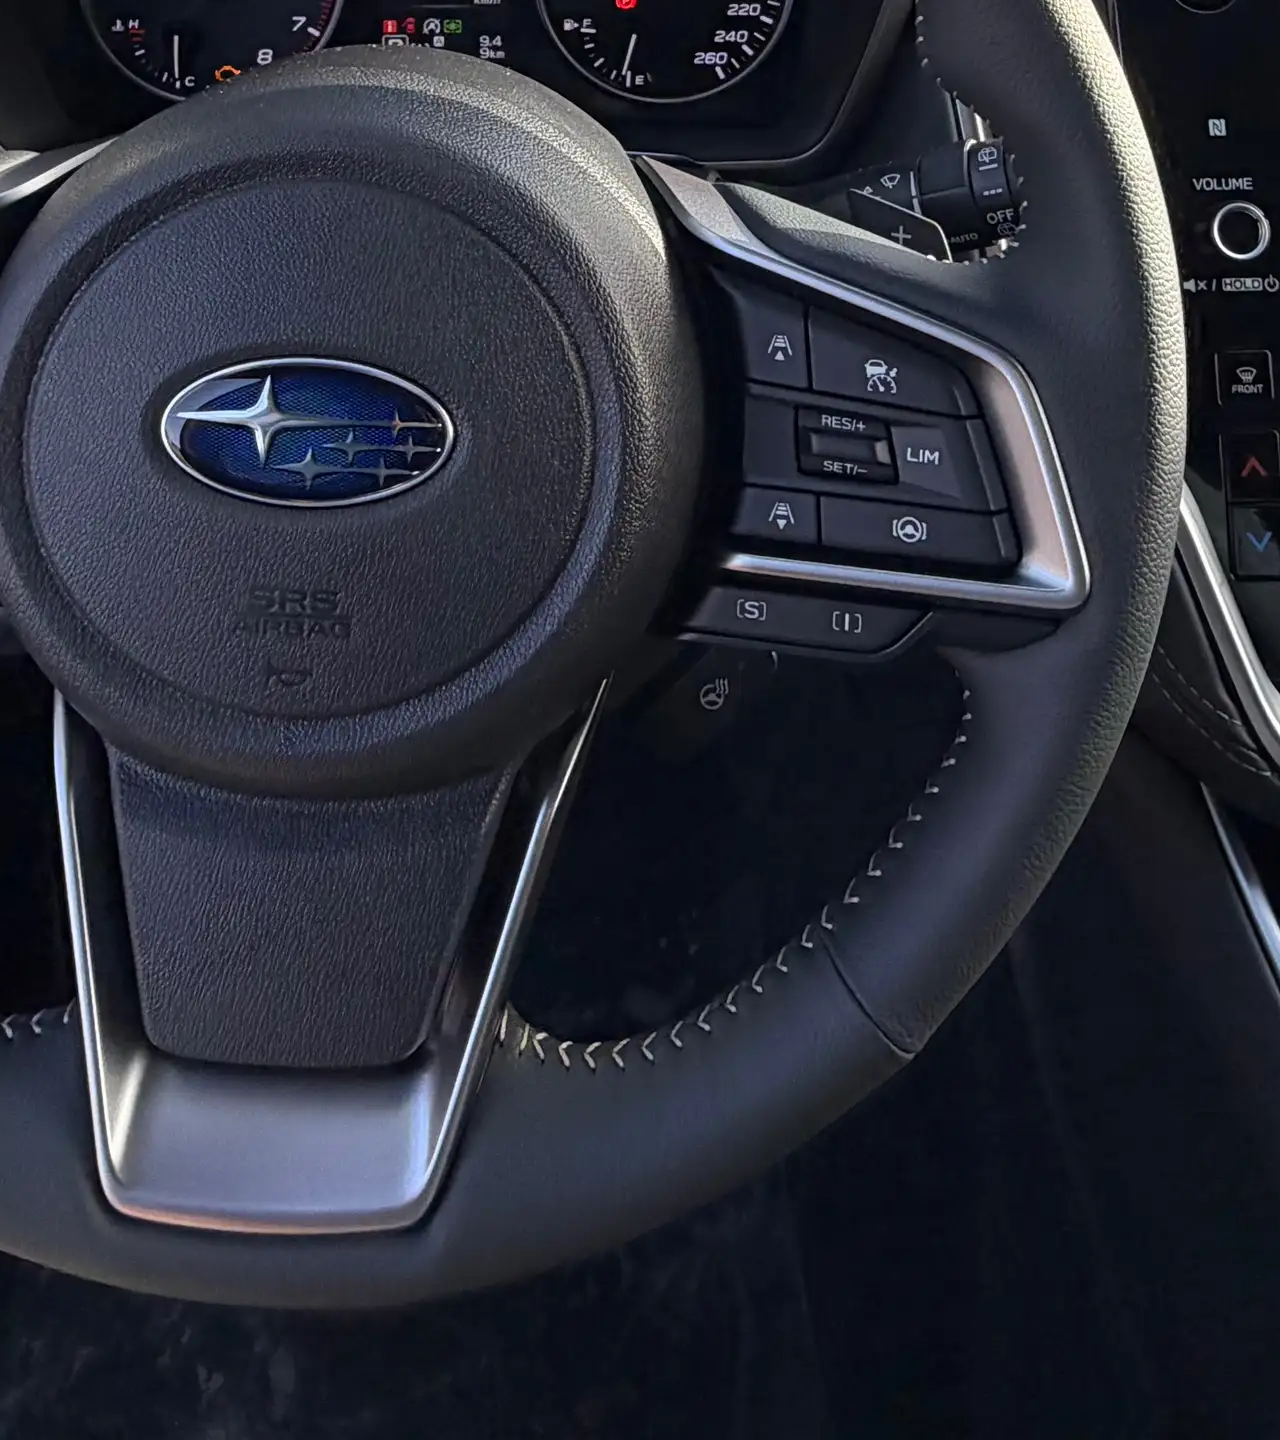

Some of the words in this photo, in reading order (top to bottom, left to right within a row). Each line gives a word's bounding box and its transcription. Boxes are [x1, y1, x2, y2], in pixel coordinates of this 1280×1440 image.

[726, 3, 761, 17] 220
[128, 19, 139, 29] H
[291, 16, 307, 31] 7
[479, 34, 502, 47] 9.4
[714, 30, 748, 43] 240
[256, 49, 274, 65] 8
[694, 51, 728, 66] 260
[185, 76, 196, 87] C
[635, 75, 645, 86] E
[1192, 177, 1253, 191] VOLUME
[986, 208, 1014, 225] OFF
[949, 232, 979, 244] AUTO
[1223, 278, 1261, 291] HOLD
[1231, 383, 1264, 395] FRONT
[906, 446, 940, 466] LIM
[250, 588, 339, 614] SRS
[232, 616, 352, 639] AIRBAG
